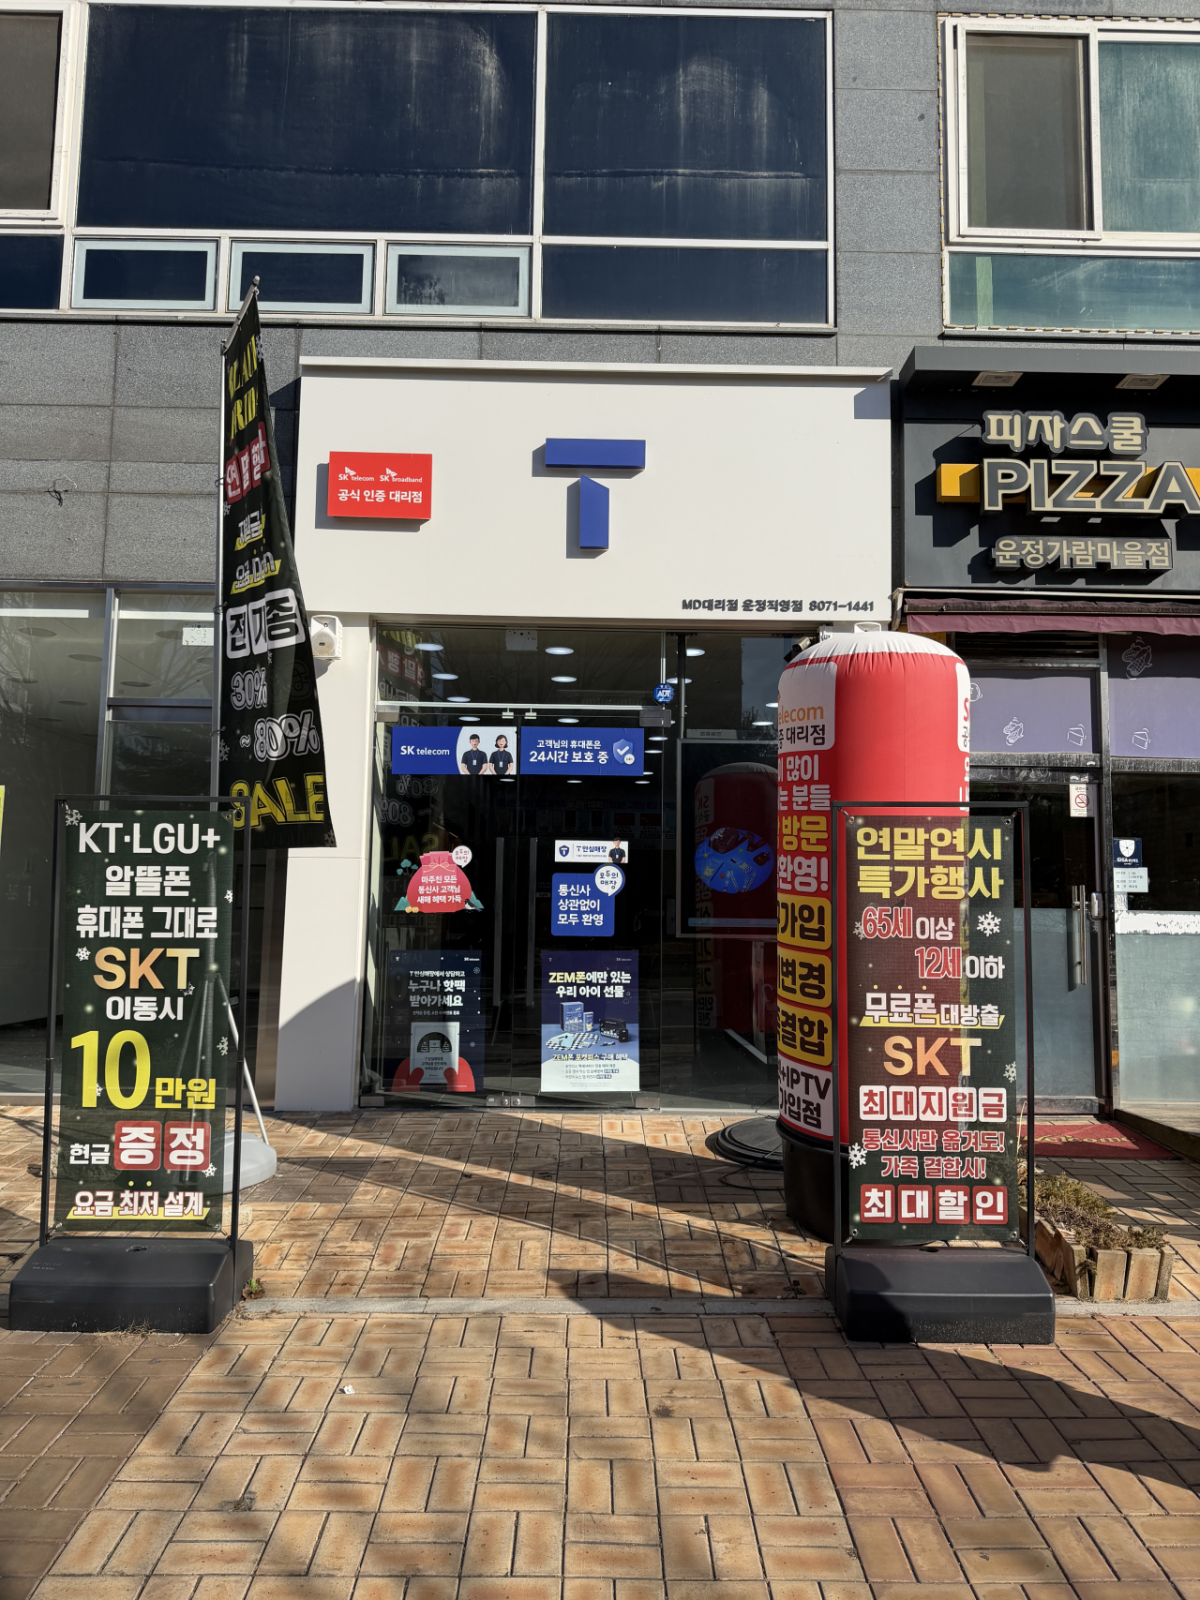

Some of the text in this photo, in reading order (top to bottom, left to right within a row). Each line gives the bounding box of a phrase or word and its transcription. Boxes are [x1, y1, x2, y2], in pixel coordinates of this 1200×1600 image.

[985, 412, 1147, 453] 피자스쿨
[338, 473, 349, 481] SK
[982, 457, 1200, 514] PIZZA
[337, 489, 423, 504] 공식 인증 대리점
[545, 438, 646, 549] T
[995, 539, 1170, 567] 운정가람마을점
[681, 599, 875, 613] MD대리점 운정직영점 8071-1441
[231, 668, 267, 711] 30%
[254, 710, 320, 763] 80%
[536, 739, 601, 750] 고객님의 휴대폰은
[786, 724, 826, 746] 대리점
[400, 746, 450, 756] SK telecom
[529, 750, 609, 765] 24시간 보호 중
[786, 754, 819, 782] 많이
[229, 772, 325, 830] SALE
[792, 784, 831, 811] 분들
[77, 822, 221, 855] KT·LGU+
[582, 845, 607, 853] 안심매장
[856, 827, 1002, 861] 연말연시
[105, 865, 191, 897] 알뜰폰
[421, 875, 458, 884] 마주친 모든
[600, 870, 619, 880] 모두의
[600, 880, 617, 890] 매장
[778, 854, 829, 893] 환영!
[857, 865, 1005, 900] 특가행사
[416, 895, 462, 904] 새해 혜택 가득
[418, 886, 439, 894] 통신사
[440, 885, 461, 894] 고객님
[557, 884, 591, 897] 통신사
[557, 899, 600, 912] 상관없이
[557, 913, 604, 926] 모두 환영
[76, 906, 218, 939] 휴대폰 그대로
[777, 901, 826, 942] 가입
[862, 906, 955, 941] 65세 이상
[93, 946, 200, 990] SKT
[915, 946, 1005, 979] 12세 이하
[408, 979, 466, 993] 누구나 핫팩
[549, 971, 632, 984] ZEM폰에만 있는
[555, 985, 625, 998] 우리 아이 선물
[778, 955, 826, 1000] 변경
[105, 996, 184, 1021] 이동시
[409, 994, 464, 1008] 받아가세요
[864, 992, 1000, 1027] 무료폰 대방출
[883, 1035, 983, 1077] SKT
[779, 1087, 822, 1130] 가입점
[862, 1089, 1005, 1119] 최대지원금
[69, 1126, 206, 1167] 현금 증정
[862, 1128, 1005, 1152] 통신사만 옮겨도!
[881, 1156, 987, 1180] 가족 결합시!
[73, 1190, 204, 1218] 요금 최저 설계
[863, 1188, 1004, 1221] 최대할인
